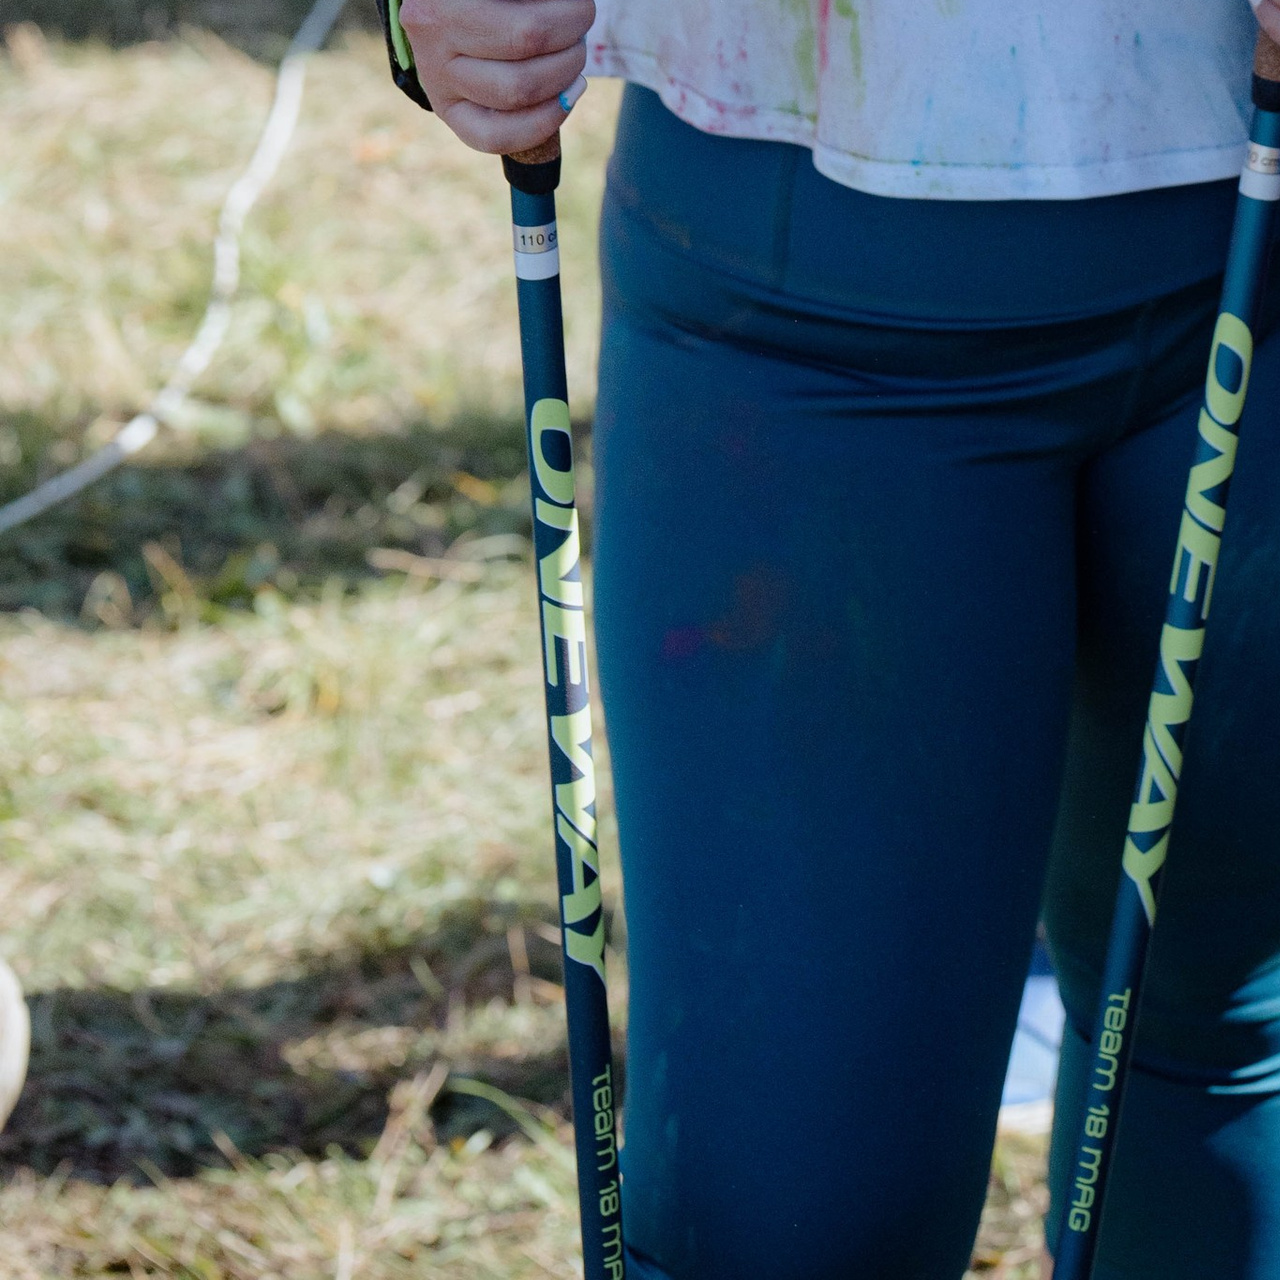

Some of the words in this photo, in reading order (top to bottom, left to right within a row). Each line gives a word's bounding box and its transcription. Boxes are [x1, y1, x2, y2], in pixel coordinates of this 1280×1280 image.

[520, 233, 545, 246] 110
[1121, 310, 1254, 928] ONEWAY
[530, 397, 608, 988] ONEWAY
[1083, 1103, 1111, 1139] 18
[598, 1180, 620, 1216] 18
